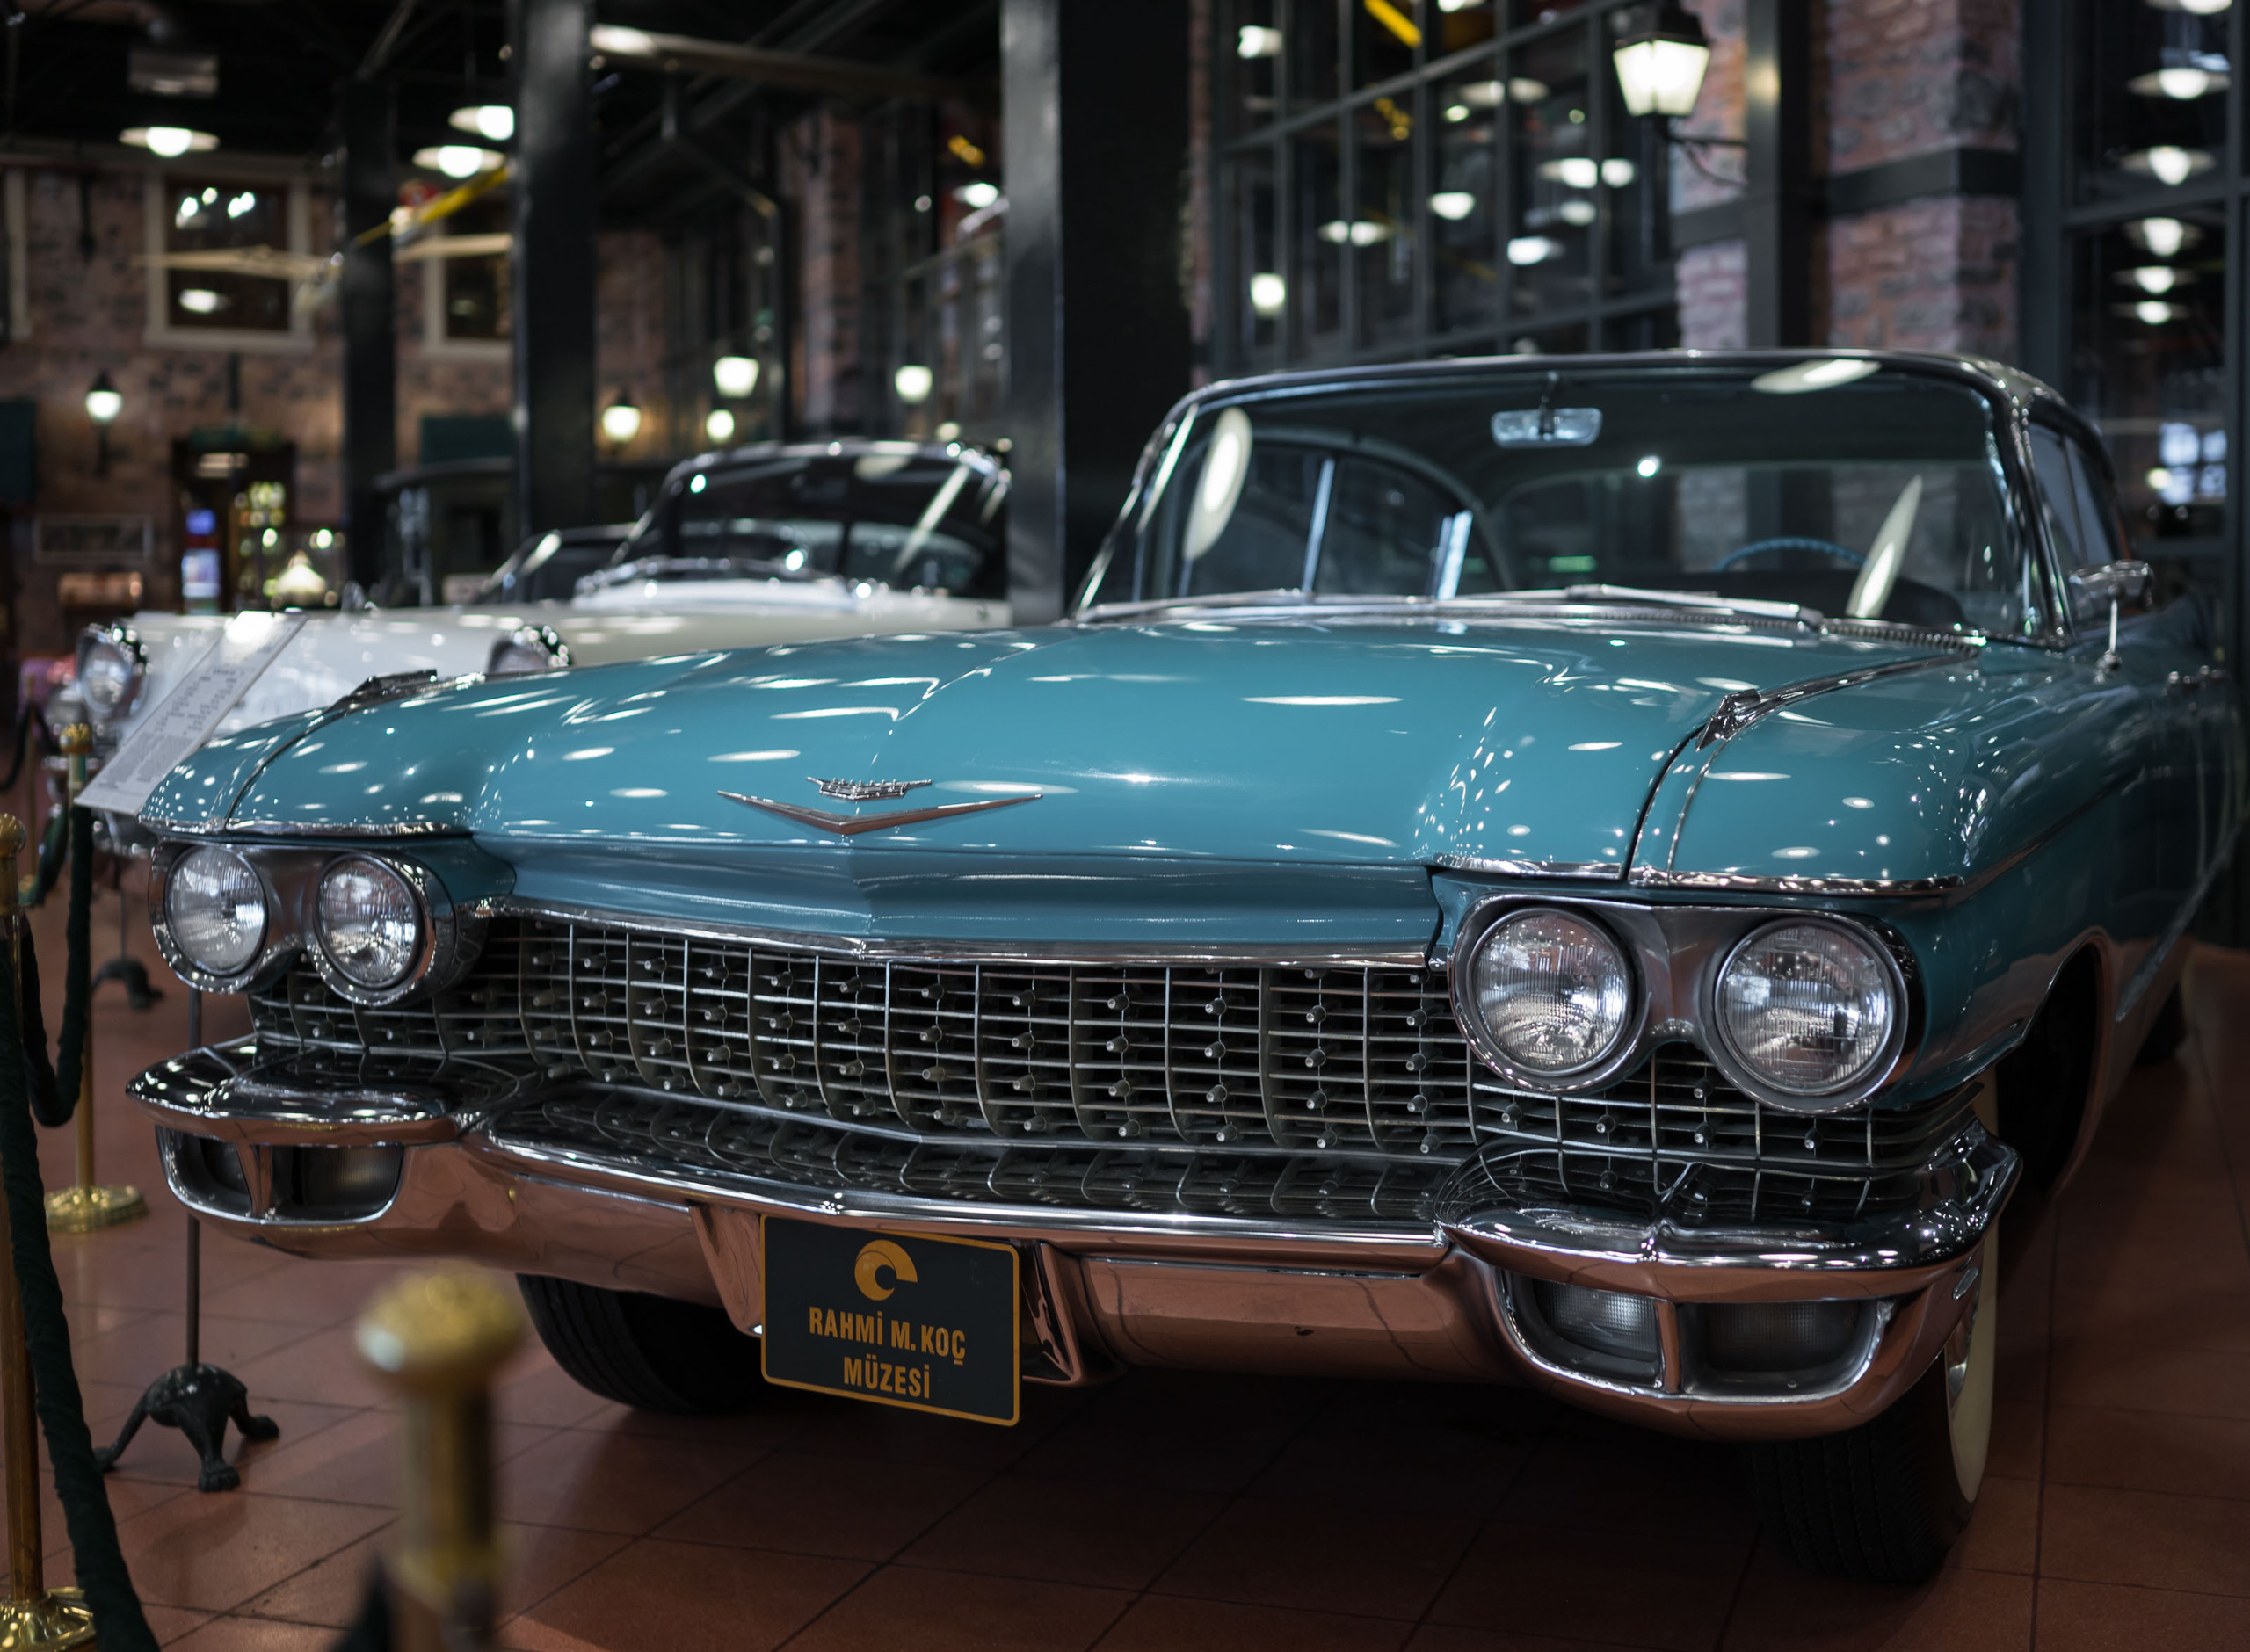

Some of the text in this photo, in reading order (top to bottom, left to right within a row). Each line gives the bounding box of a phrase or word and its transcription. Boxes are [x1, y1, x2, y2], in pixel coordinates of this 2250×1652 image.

[809, 1306, 883, 1345] RAHMİ
[921, 1324, 966, 1366] KOÇ
[843, 1353, 930, 1399] MÜZESİ
